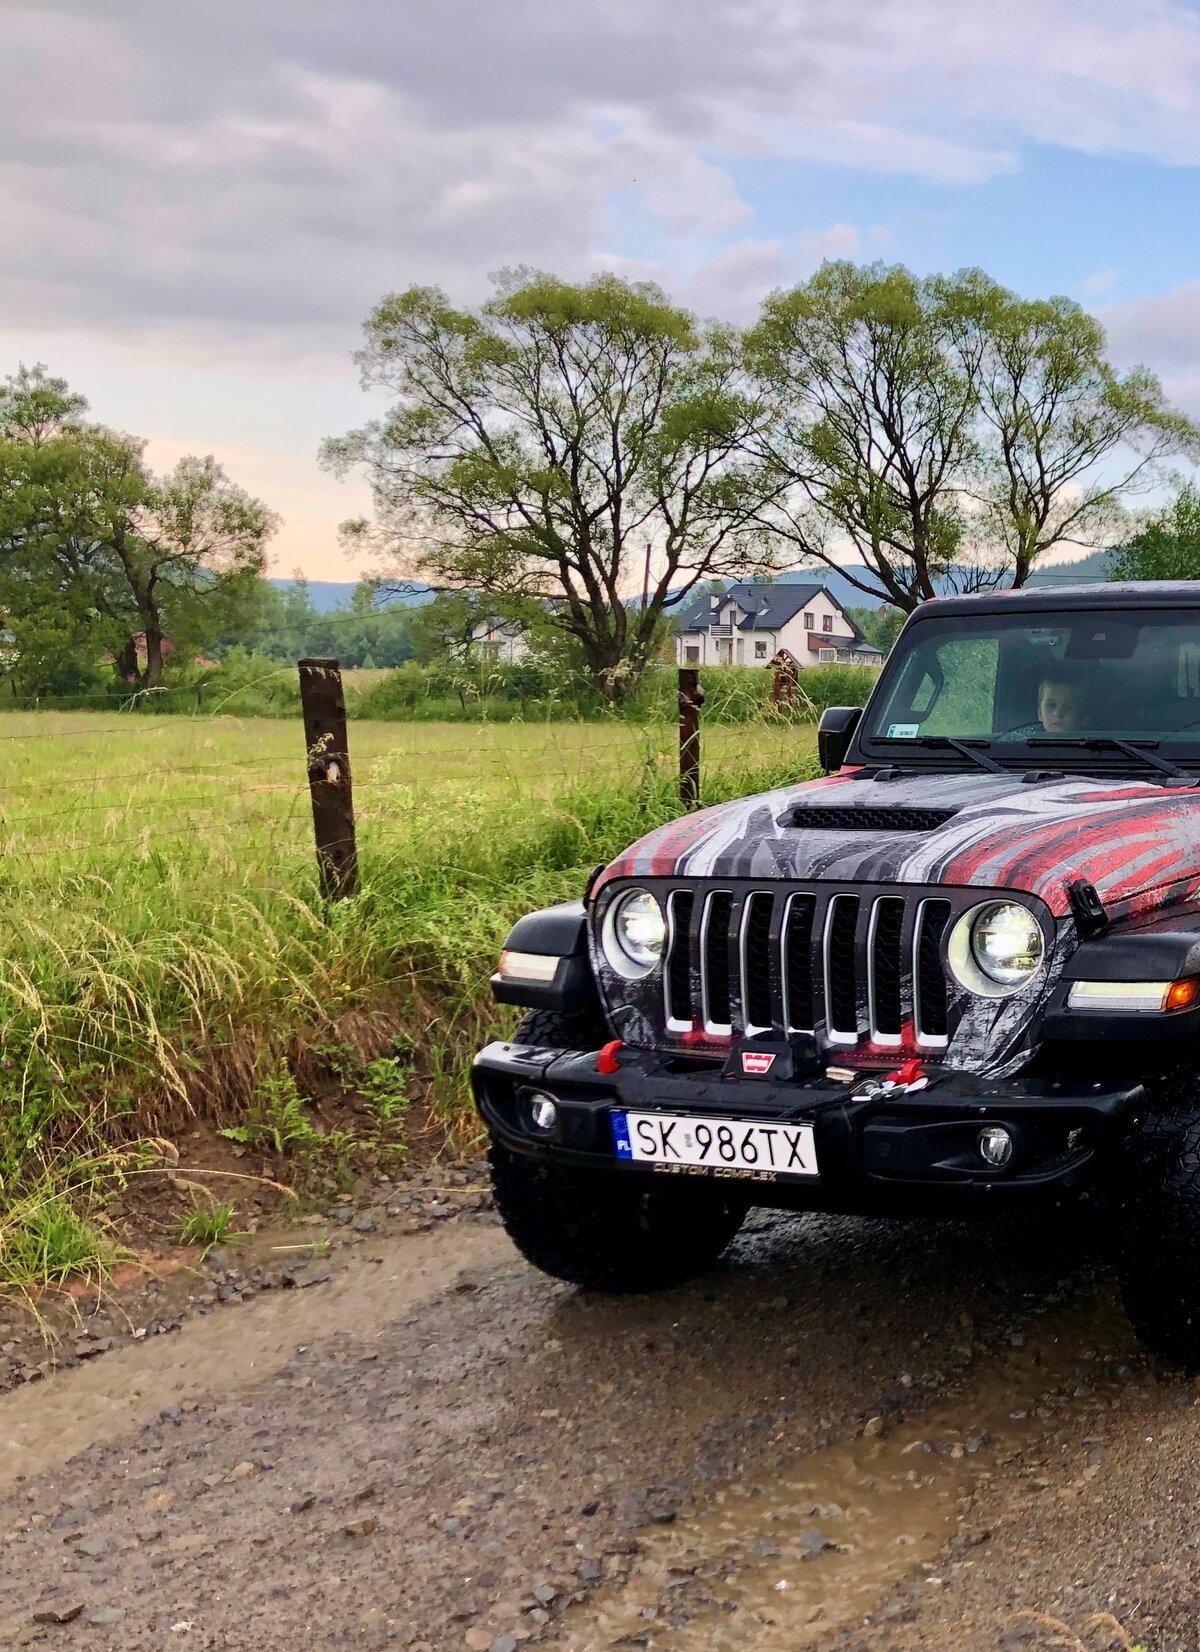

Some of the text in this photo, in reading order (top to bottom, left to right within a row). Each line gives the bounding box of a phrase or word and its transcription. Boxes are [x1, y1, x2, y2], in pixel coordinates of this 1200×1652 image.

[617, 1140, 631, 1151] PL
[637, 1119, 806, 1169] SK 986TX
[653, 1163, 777, 1182] CUSTOM COMPLEX
